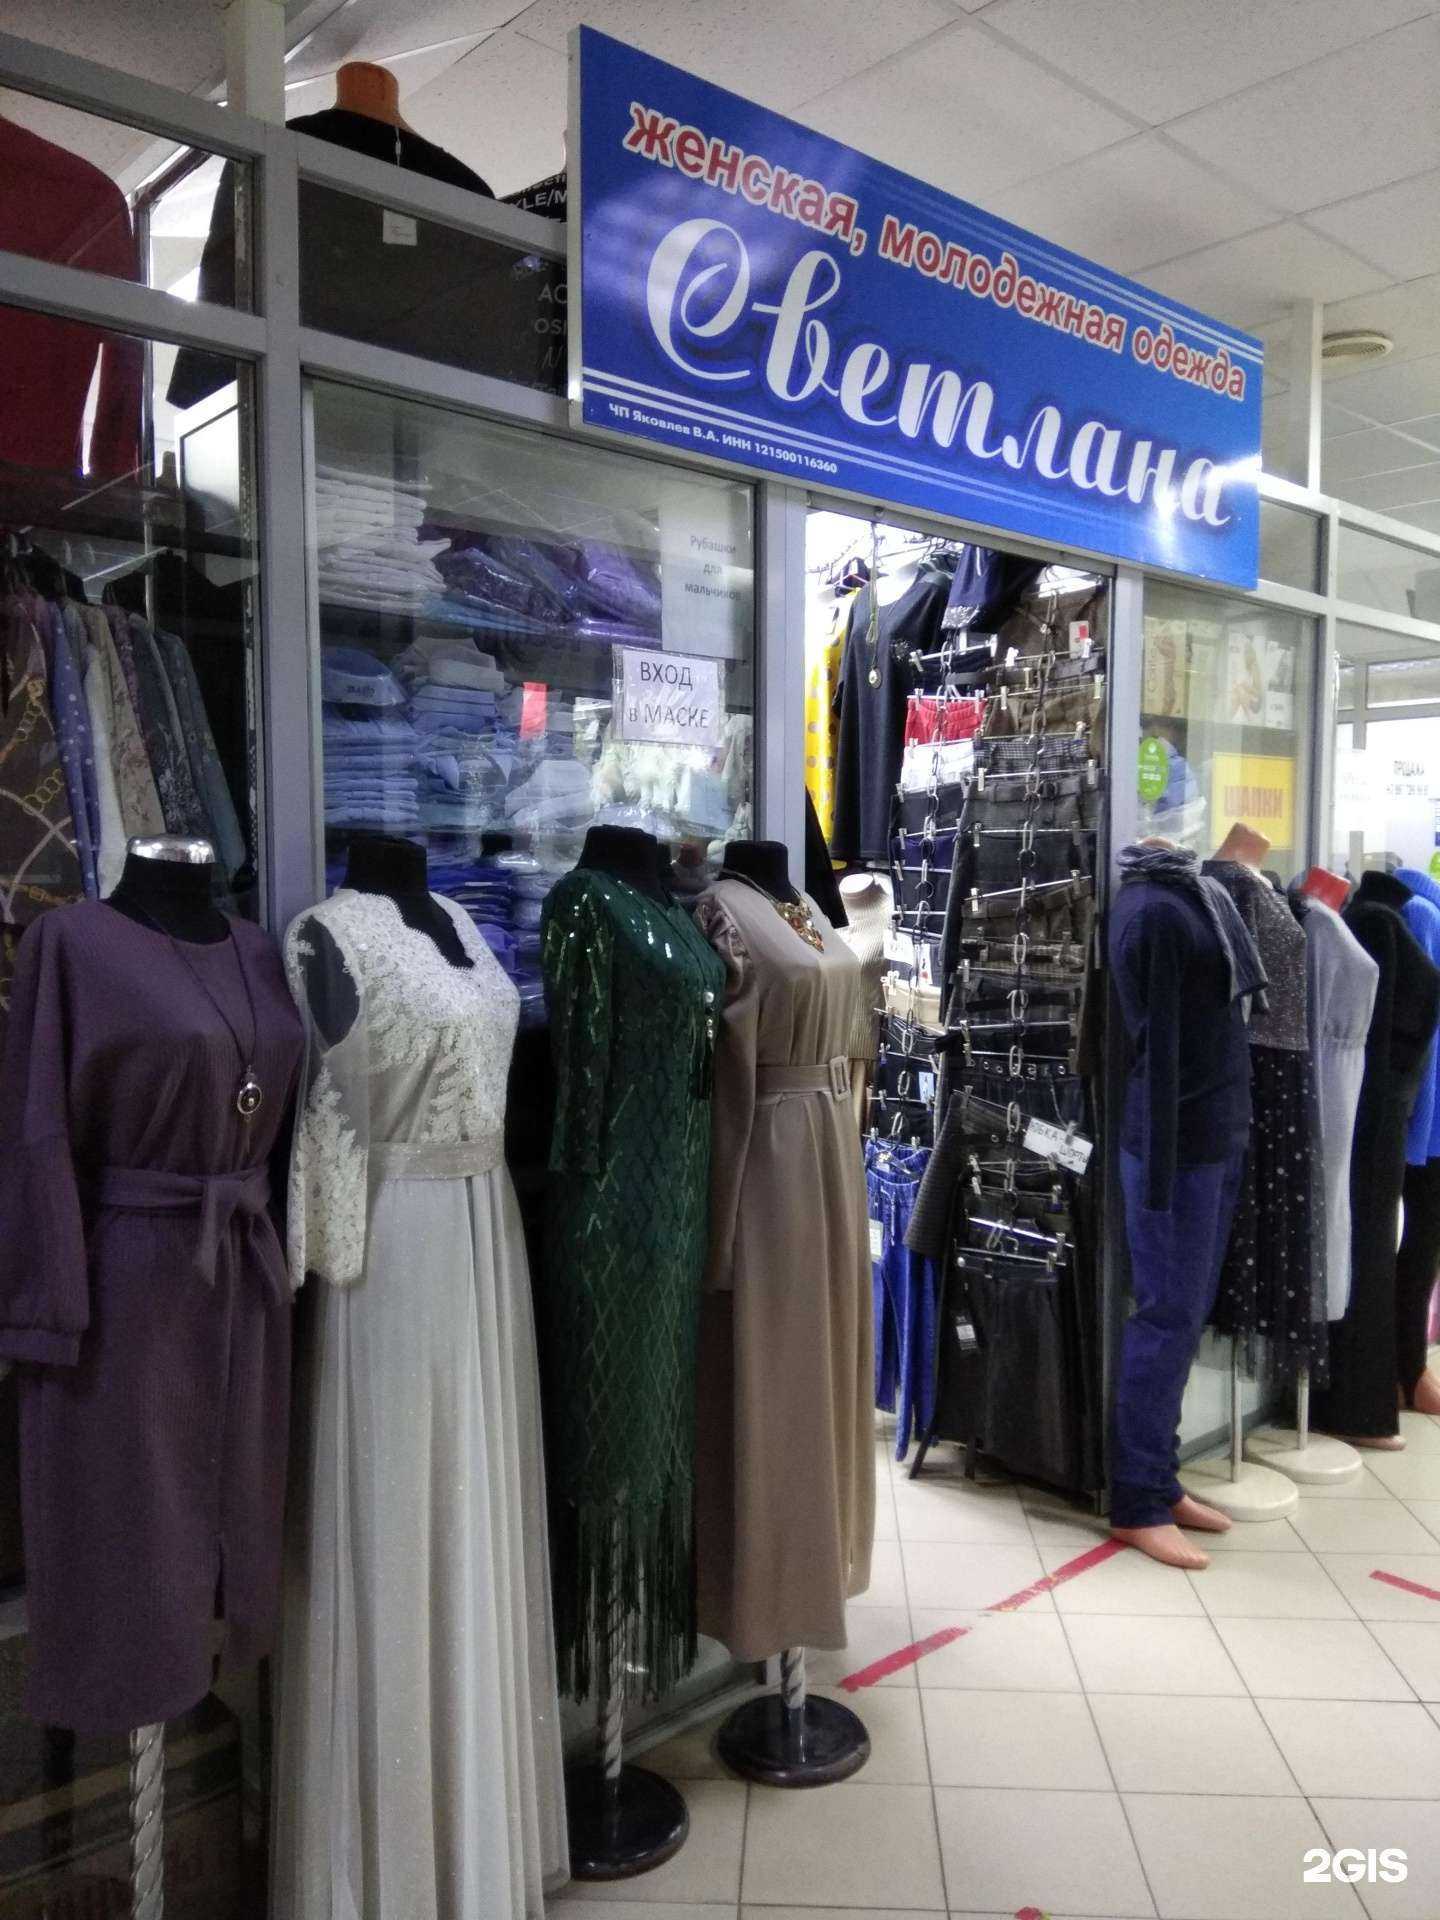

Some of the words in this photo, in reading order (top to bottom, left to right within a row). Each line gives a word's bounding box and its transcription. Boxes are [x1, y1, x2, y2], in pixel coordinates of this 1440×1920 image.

[622, 101, 867, 257] женская,
[878, 214, 1127, 354] молодежная
[1131, 323, 1246, 402] одежда
[646, 217, 1233, 527] Светлана
[608, 402, 630, 419] ЧП
[632, 408, 690, 435] Яковлев
[692, 424, 720, 443] В.А.
[722, 433, 752, 452] ИНН
[754, 441, 838, 474] 121500116360
[690, 535, 736, 554] Рубашки
[640, 661, 693, 691] ВХОД
[644, 703, 710, 729] МАСКЕ
